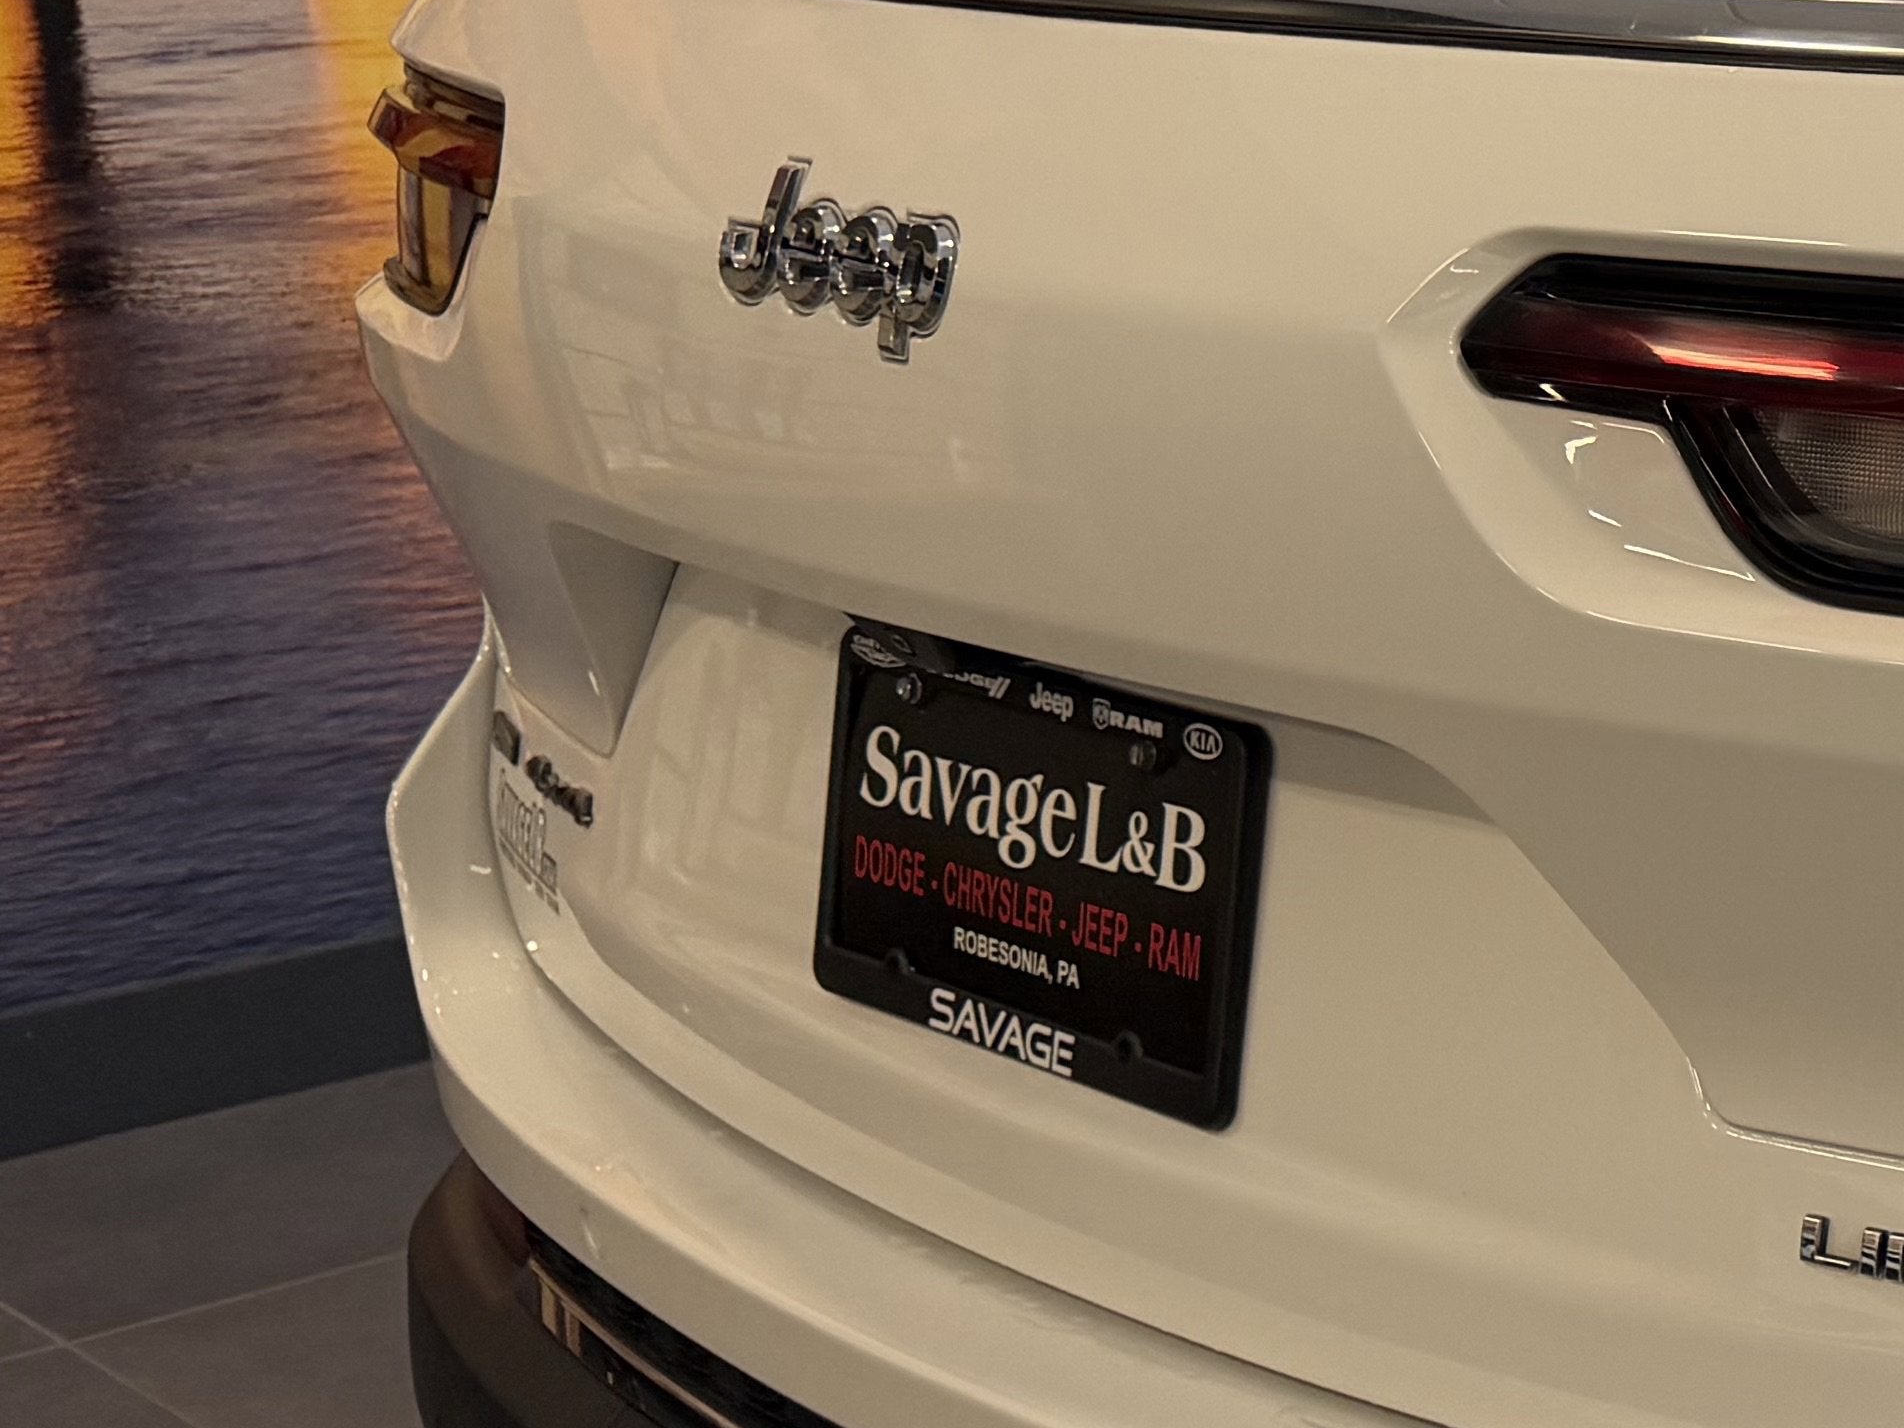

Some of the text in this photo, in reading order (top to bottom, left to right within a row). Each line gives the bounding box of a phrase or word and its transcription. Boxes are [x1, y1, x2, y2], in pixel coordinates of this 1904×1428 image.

[718, 155, 961, 364] Jeep
[1029, 681, 1074, 723] Jeep
[1108, 709, 1164, 740] RAM
[854, 834, 1202, 981] DODGE CHRYSLER JEEP RAM
[953, 926, 1081, 990] ROBESONIA, PA
[928, 987, 1077, 1078] SAVAGE
